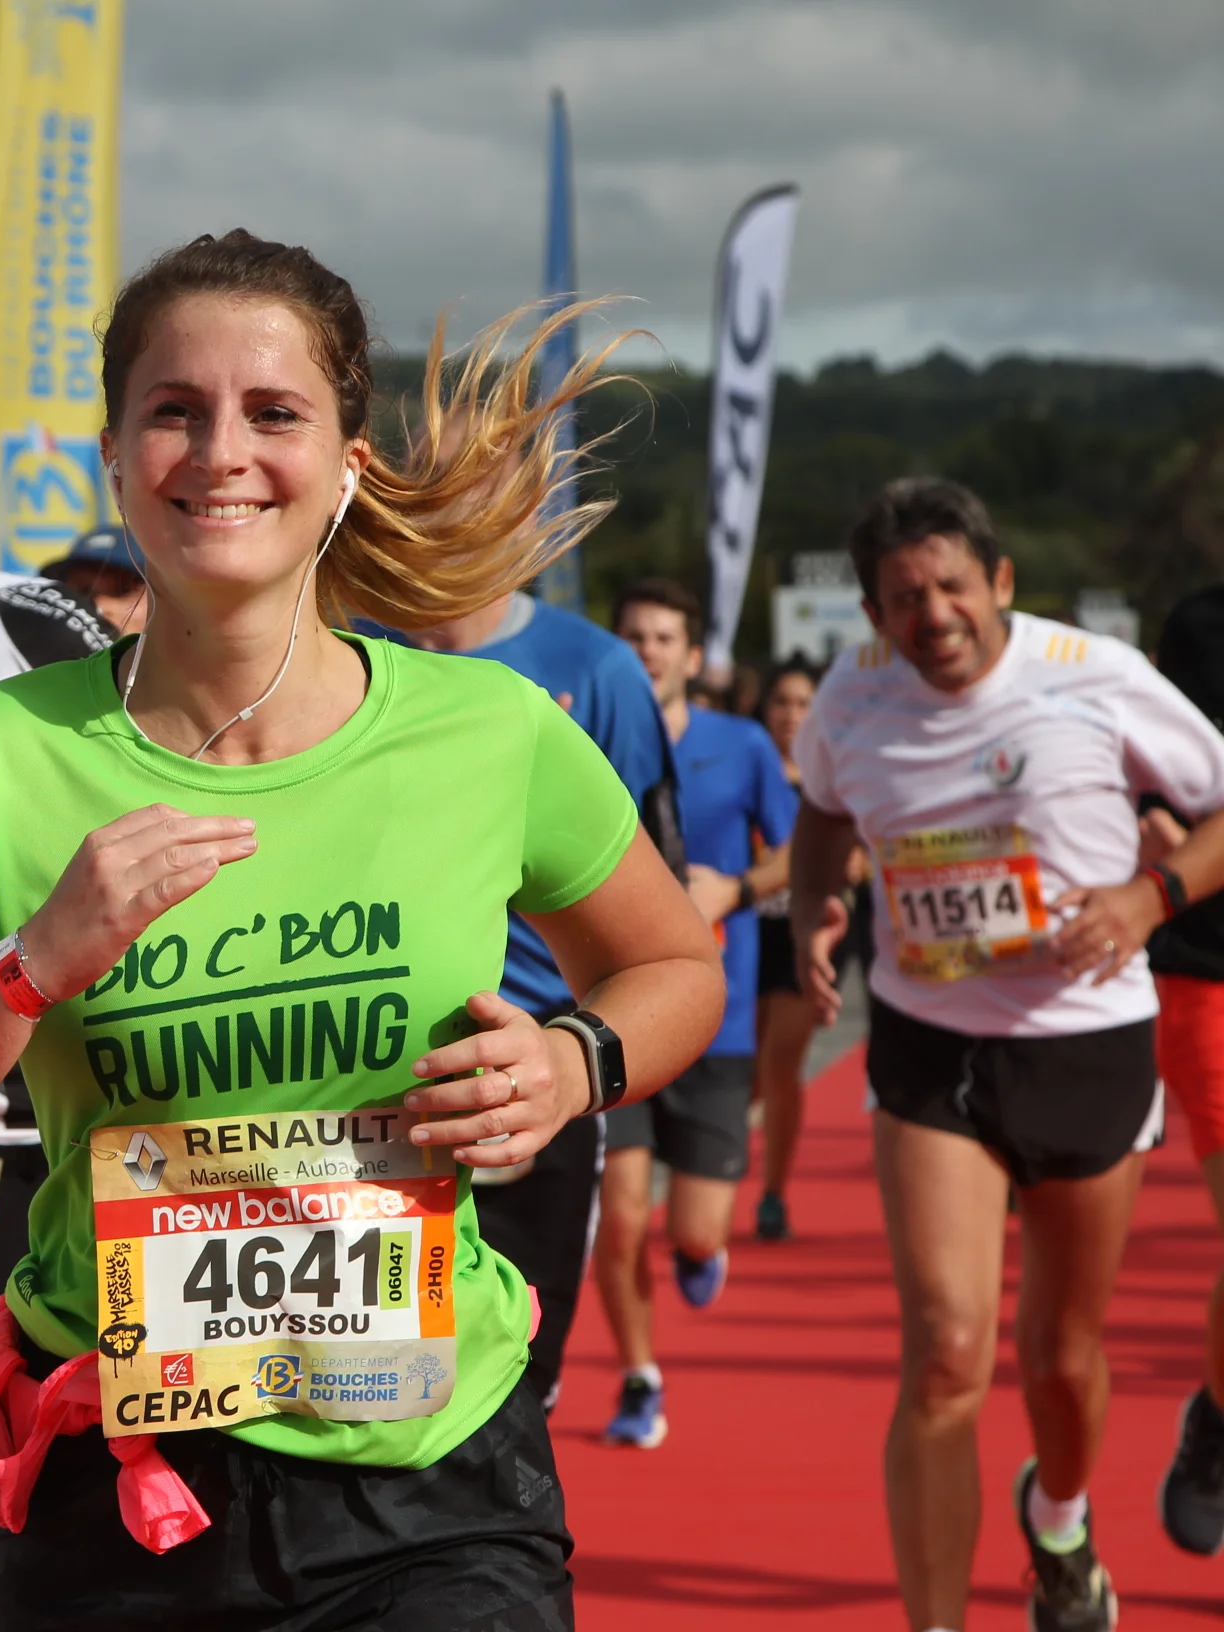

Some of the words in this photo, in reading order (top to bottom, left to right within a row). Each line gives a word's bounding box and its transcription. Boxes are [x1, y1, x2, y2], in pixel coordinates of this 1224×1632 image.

[29, 111, 58, 399] BOUCHES
[63, 325, 96, 400] DU
[901, 881, 1018, 929] 11514
[280, 901, 401, 965] BON
[85, 992, 409, 1110] RUNNING
[184, 1114, 398, 1157] RENAULT
[190, 1161, 279, 1187] Marseille
[294, 1156, 390, 1181] Aubagne
[152, 1201, 231, 1233] new
[239, 1188, 405, 1227] balance
[183, 1227, 381, 1314] 4641
[388, 1242, 404, 1302] 06047
[428, 1245, 445, 1309] -2H00
[113, 1338, 134, 1355] 40
[203, 1313, 370, 1341] BOUYSSOU
[265, 1358, 293, 1388] 13
[309, 1388, 335, 1401] DU
[339, 1386, 399, 1401] RHÔNE
[310, 1372, 399, 1386] BOUCHES
[116, 1384, 240, 1427] CEPAC
